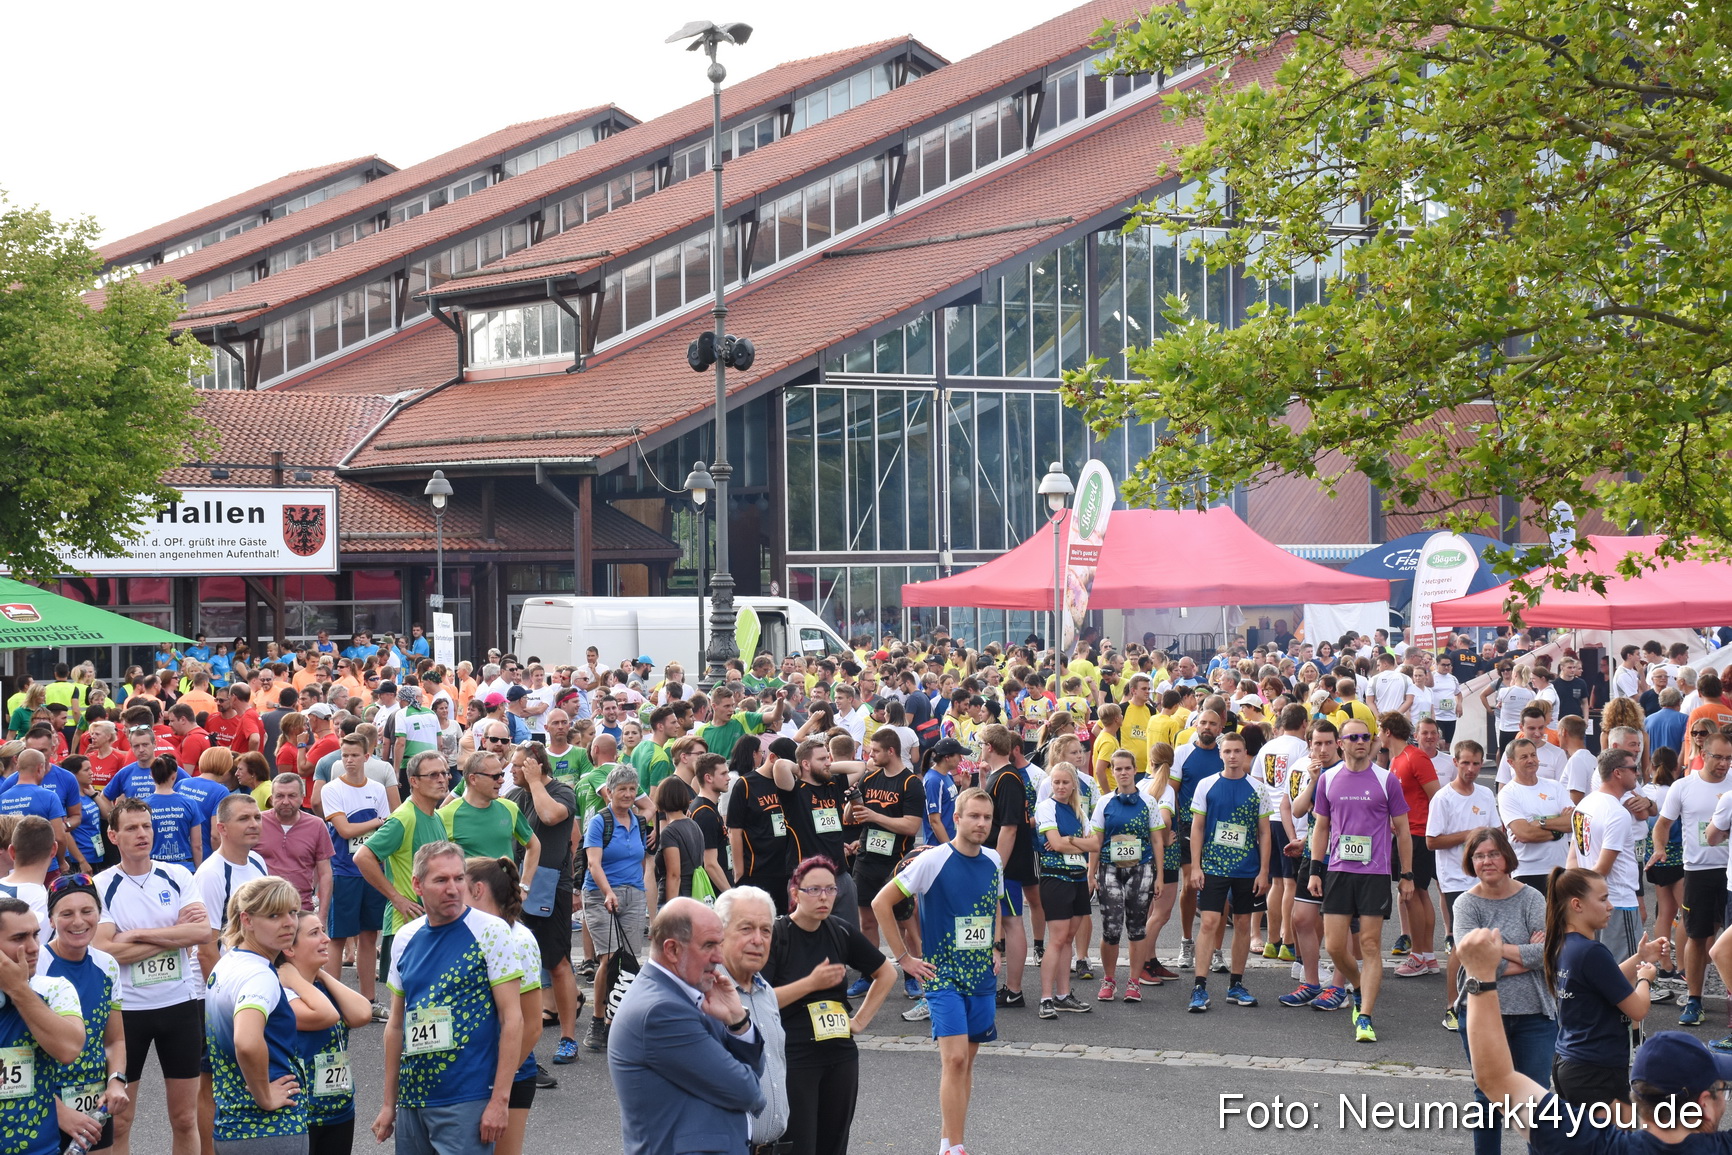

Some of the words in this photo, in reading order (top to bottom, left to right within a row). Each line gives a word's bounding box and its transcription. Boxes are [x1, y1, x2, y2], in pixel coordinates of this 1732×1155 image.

[156, 501, 264, 524] Hallen
[152, 538, 160, 546] d.
[164, 538, 186, 546] OPf.
[188, 538, 214, 548] grüßt
[218, 538, 236, 546] ihre
[240, 538, 268, 546] Gäste
[160, 550, 224, 560] angenehmen
[226, 550, 280, 558] Aufenthalt!
[1432, 552, 1462, 564] Bögerl
[1424, 577, 1452, 586] Metzgerei
[1424, 588, 1456, 597] Partyservice
[0, 624, 79, 634] eumarkter
[0, 631, 104, 643] ammsbräu
[1460, 654, 1476, 663] B+B
[870, 789, 900, 803] WINGS
[820, 816, 836, 826] 286
[1220, 830, 1240, 841] 254
[870, 838, 888, 848] 282
[1117, 847, 1134, 856] 236
[1344, 844, 1364, 854] 900
[965, 928, 986, 940] 240
[138, 958, 176, 974] 1878
[818, 1014, 846, 1028] 1976
[412, 1024, 436, 1042] 241
[0, 1066, 22, 1084] 45
